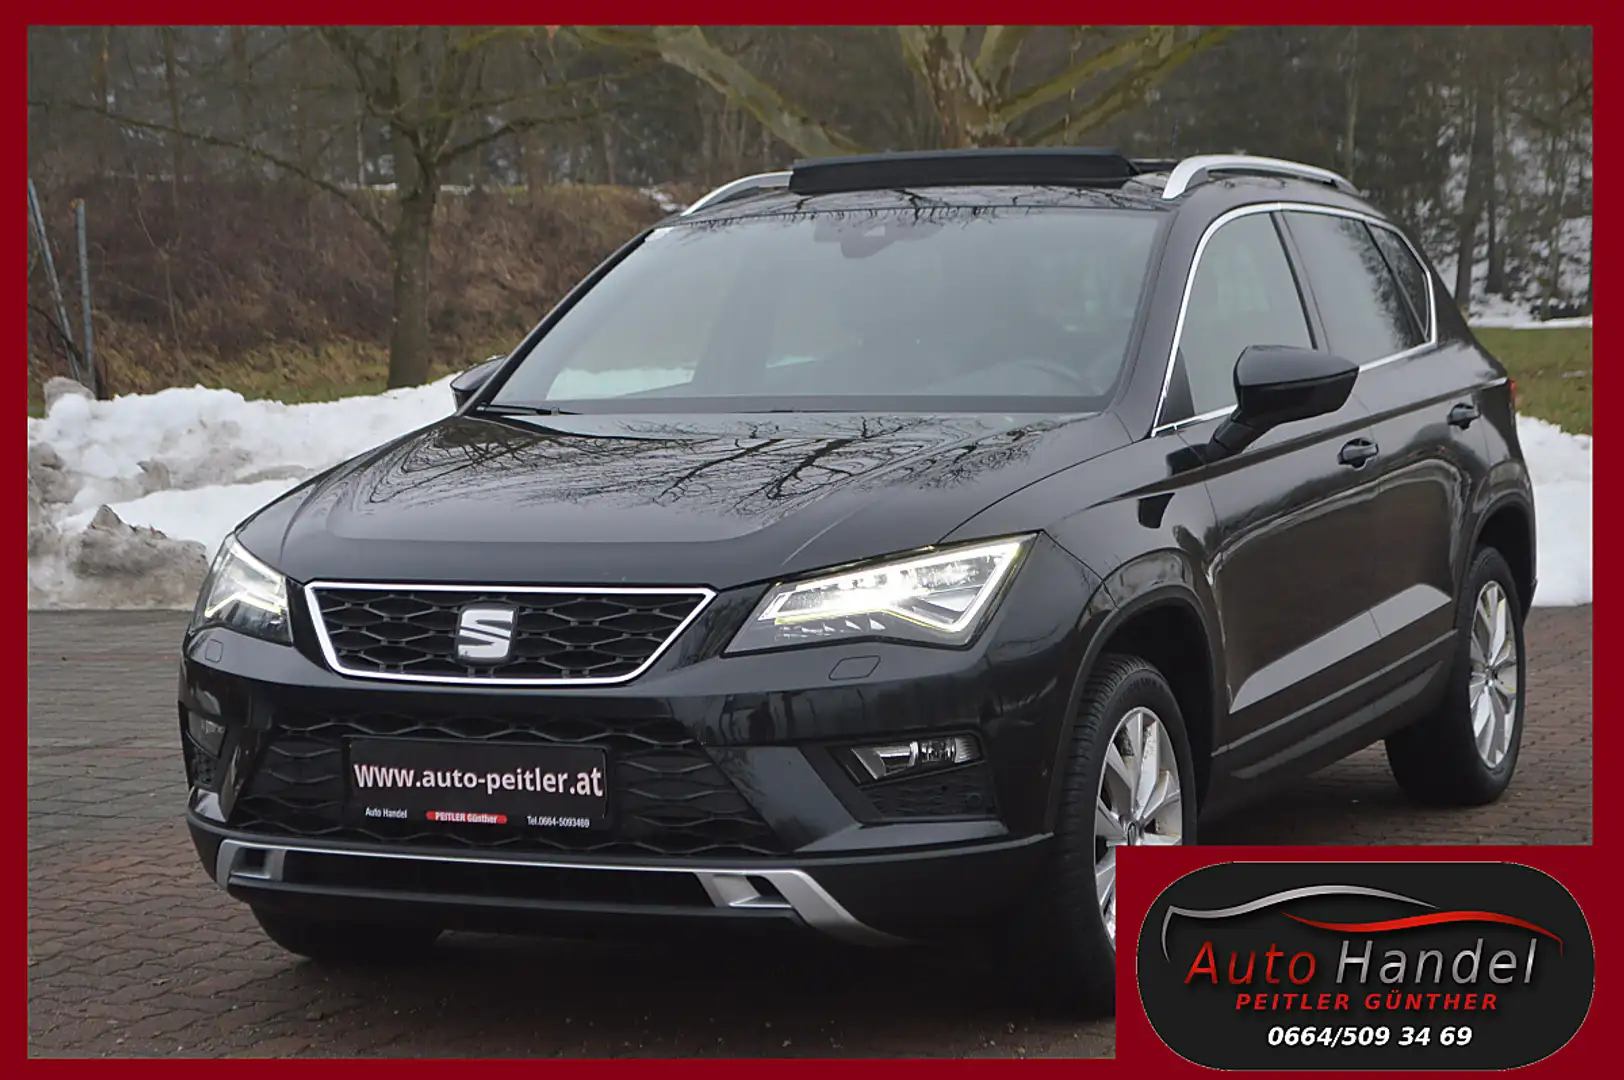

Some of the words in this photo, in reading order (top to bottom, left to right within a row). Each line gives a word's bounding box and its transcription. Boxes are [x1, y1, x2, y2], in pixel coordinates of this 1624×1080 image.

[365, 806, 382, 817] Auto
[382, 808, 408, 819] Handel
[435, 811, 466, 821] PEITLER
[466, 813, 498, 824] Günther
